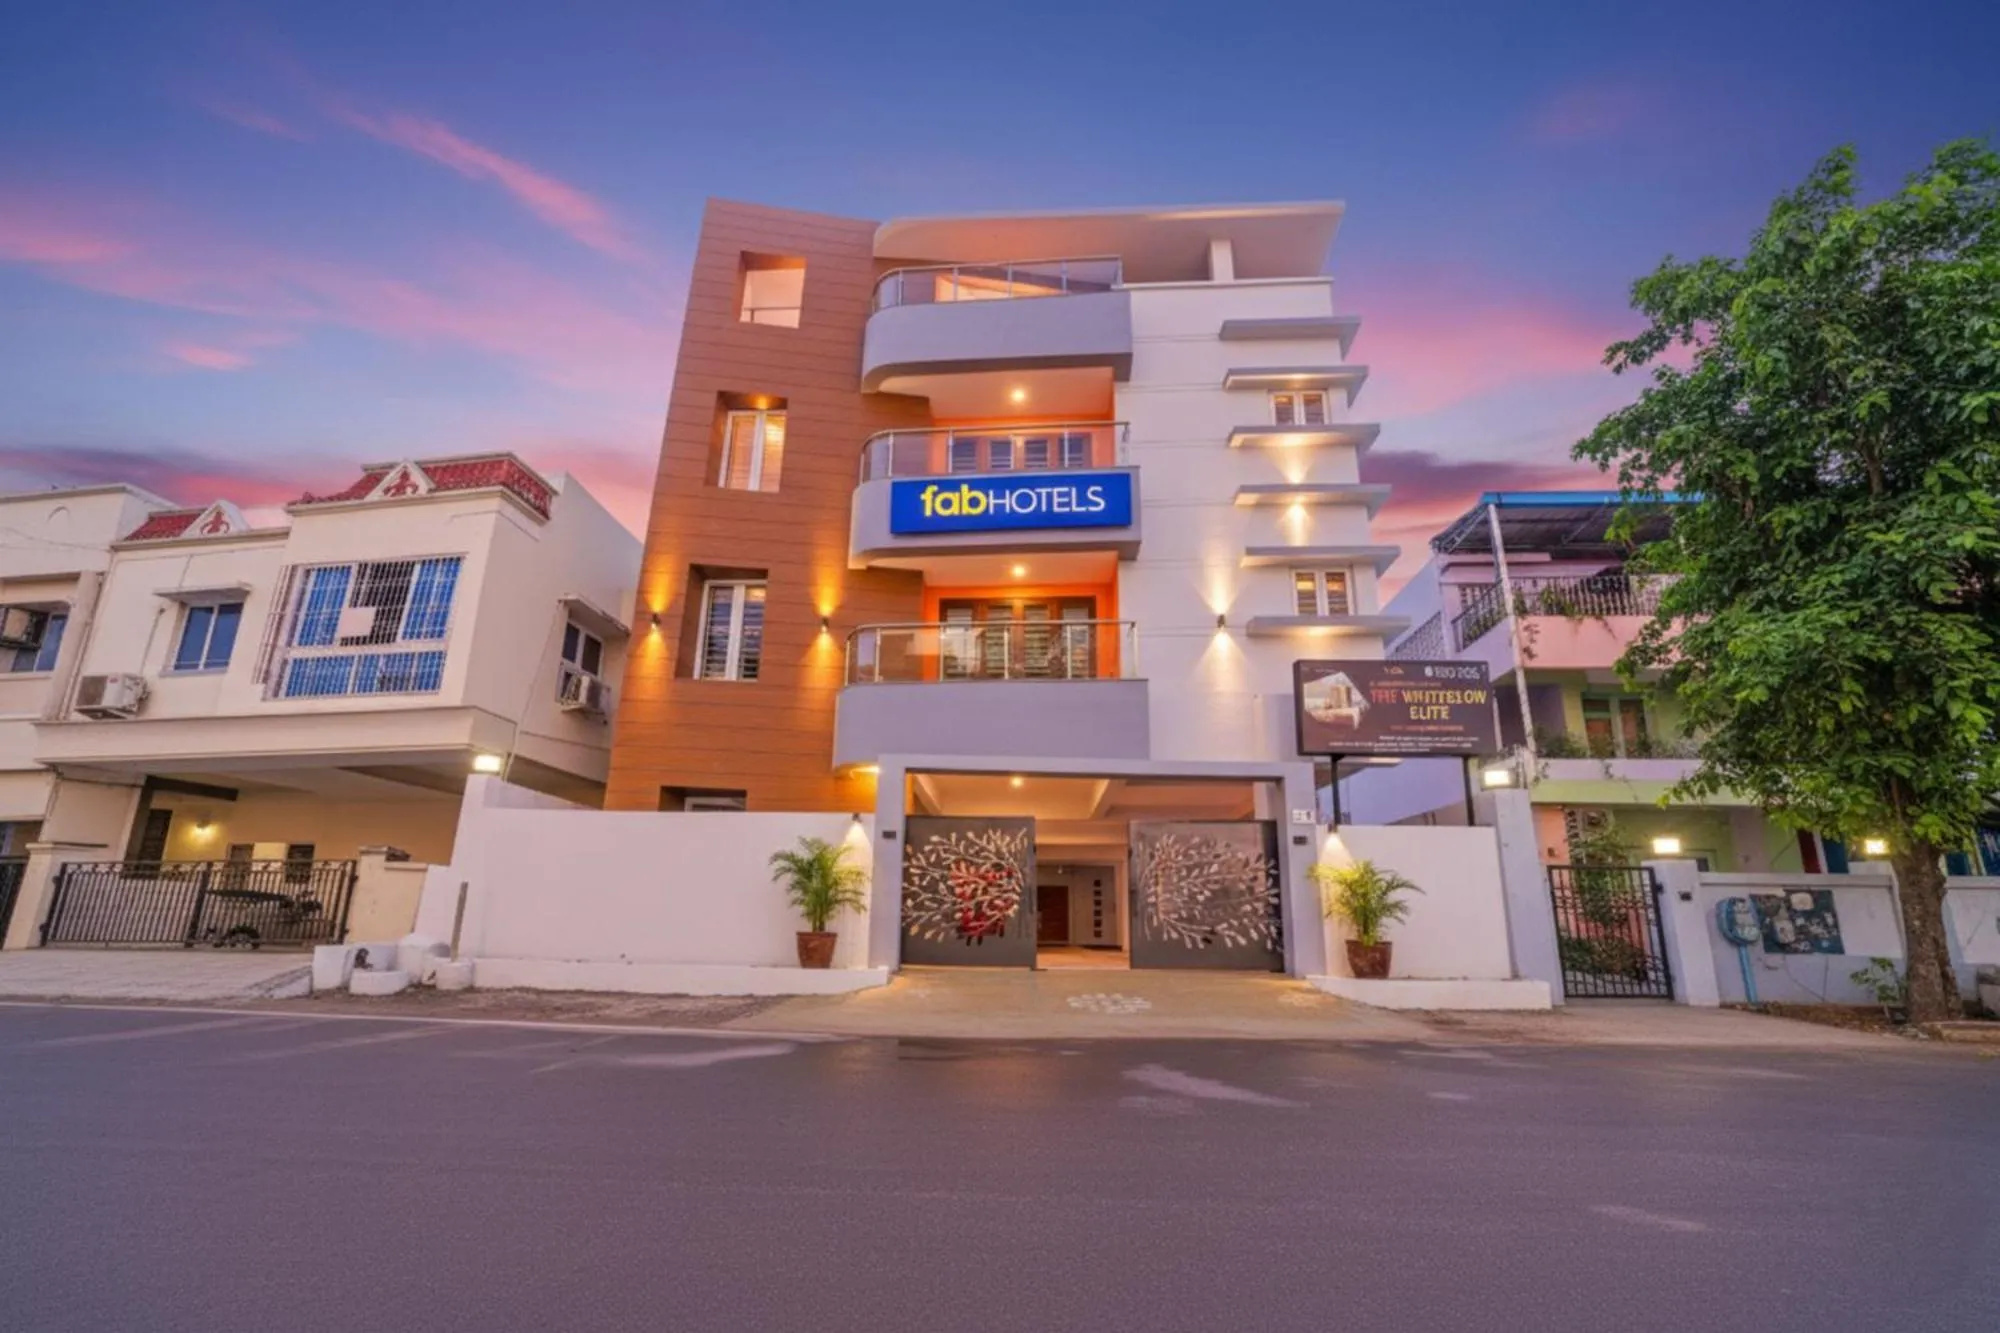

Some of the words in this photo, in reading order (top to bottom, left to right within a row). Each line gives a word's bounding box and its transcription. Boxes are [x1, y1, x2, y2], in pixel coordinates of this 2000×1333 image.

[920, 484, 1106, 517] fabHOTELS
[1370, 689, 1397, 704] THE
[1409, 705, 1450, 720] ELITE
